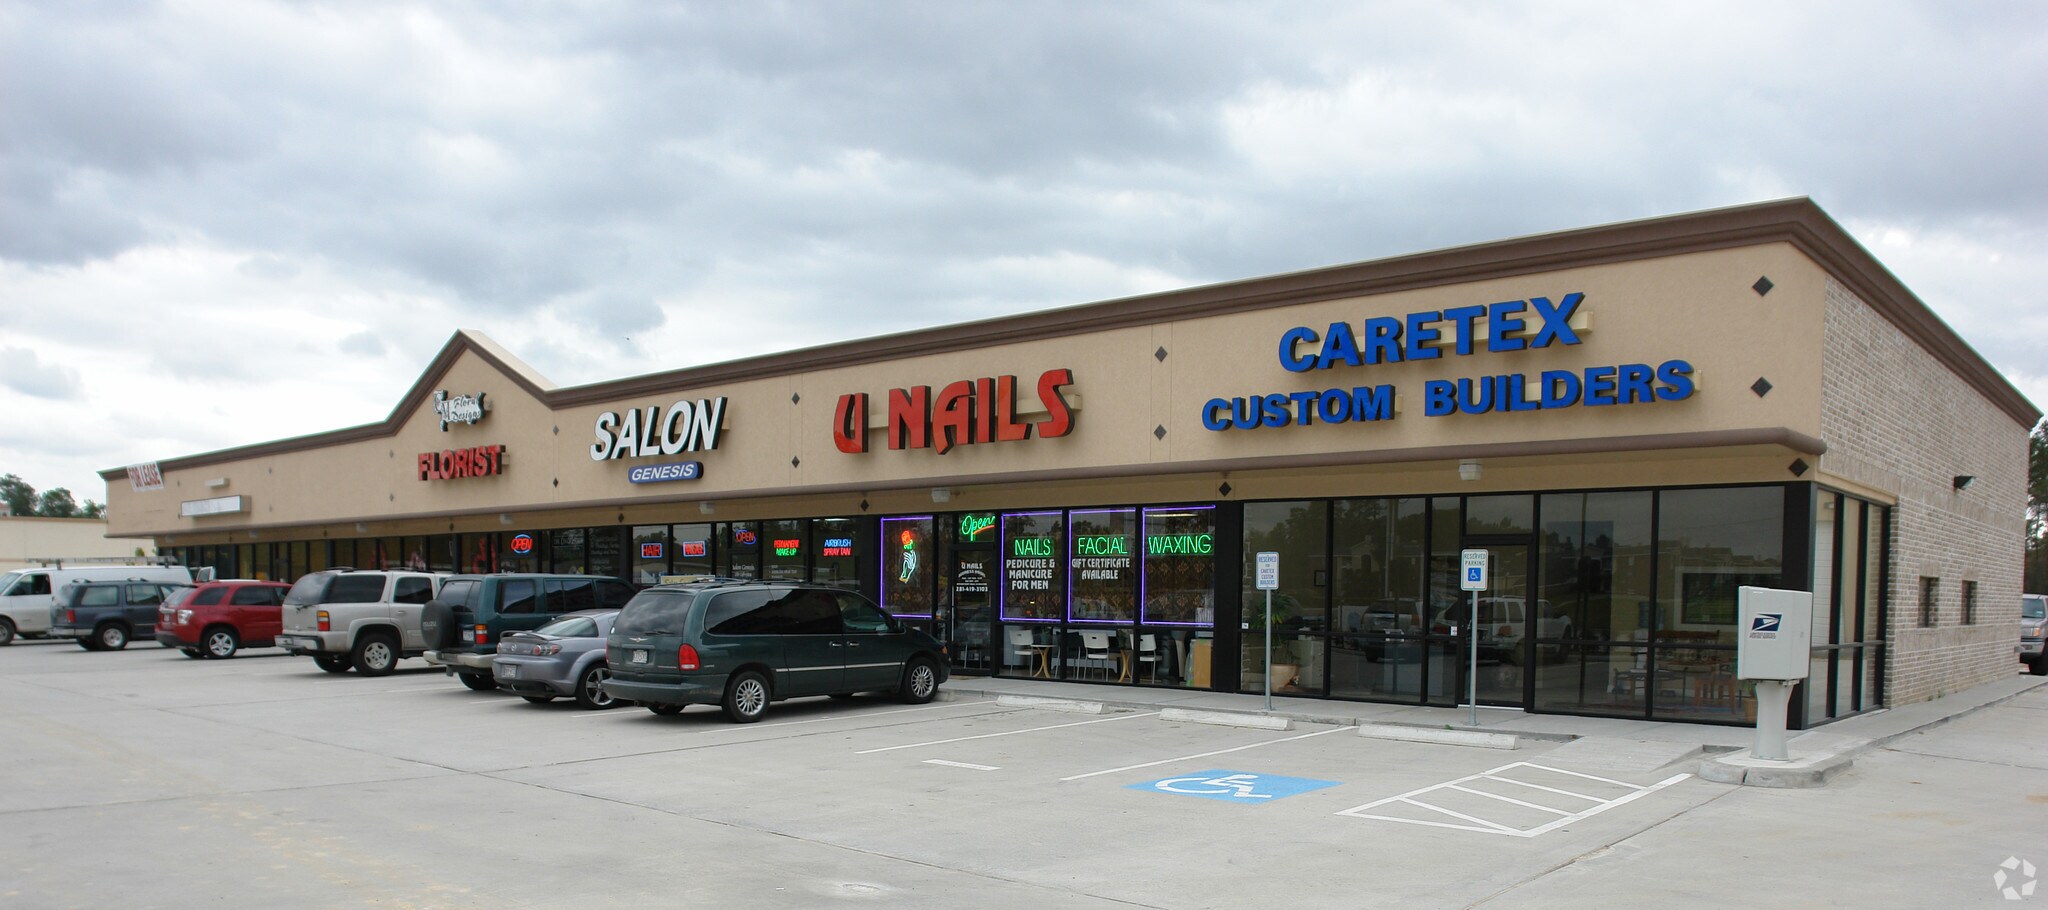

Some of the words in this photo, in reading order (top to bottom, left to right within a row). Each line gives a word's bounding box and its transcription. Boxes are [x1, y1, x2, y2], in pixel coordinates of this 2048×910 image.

[1279, 292, 1586, 372] CARETEX
[453, 394, 482, 408] Floral
[1201, 384, 1395, 431] CUSTOM
[1425, 359, 1694, 417] BUILDERS
[451, 410, 481, 423] Designs
[834, 393, 868, 453] U
[888, 368, 1074, 455] NAILS
[590, 397, 727, 460] SALON
[418, 444, 506, 480] FLORIST
[129, 466, 143, 488] FOR
[140, 463, 160, 486] LEASE
[632, 464, 694, 480] GENESIS
[961, 515, 995, 541] Open
[511, 537, 533, 551] OPEN
[736, 531, 754, 543] OPEN
[824, 539, 851, 547] AIRBRUSH
[1148, 534, 1211, 554] WAXING
[643, 545, 660, 556] HAIR
[776, 548, 797, 556] MAKE-UP
[823, 548, 839, 556] SPRAY
[840, 548, 851, 556] TAN
[1014, 538, 1051, 556] NAILS
[1078, 536, 1127, 554] FACIAL
[1006, 559, 1047, 568] PEDICURE
[1049, 559, 1055, 568] &
[1072, 558, 1086, 568] GIFT
[1087, 558, 1130, 568] CERTIFICATE
[1009, 569, 1052, 579] MANICURE
[1081, 569, 1119, 579] AVAILABLE
[1012, 580, 1029, 590] FOR
[1031, 580, 1049, 590] MEN
